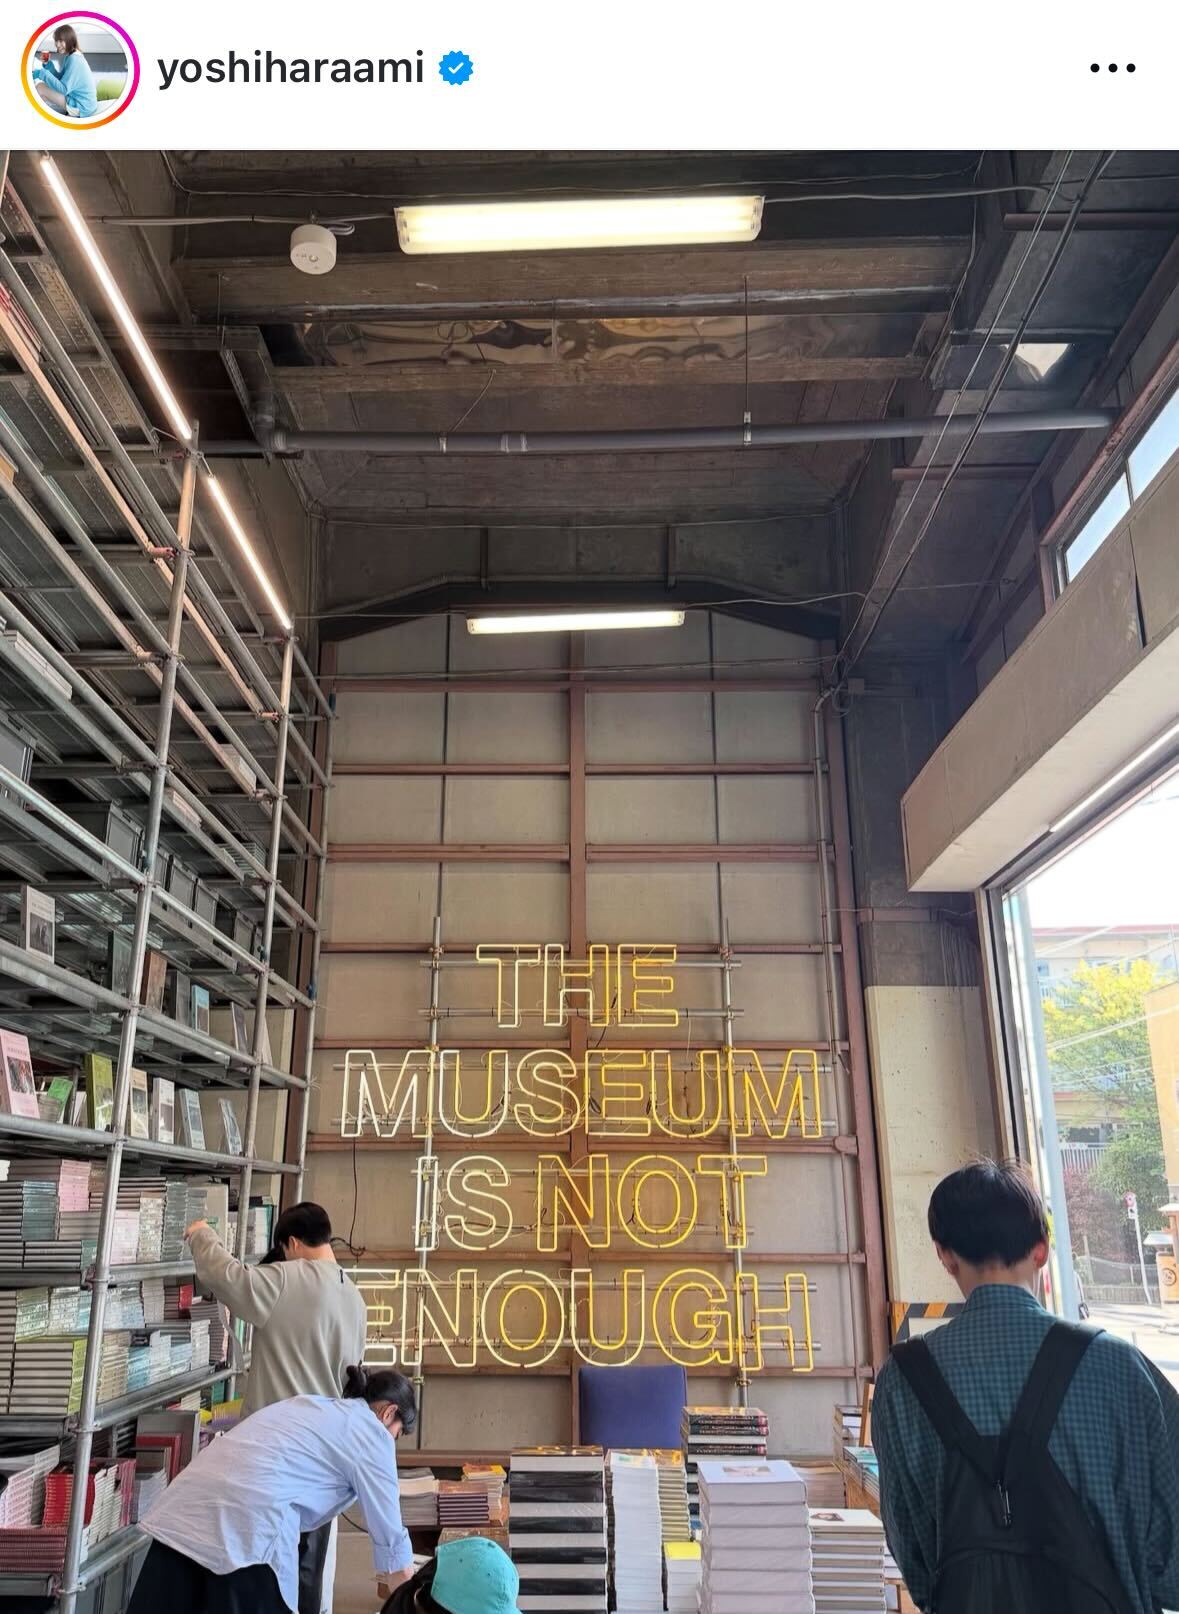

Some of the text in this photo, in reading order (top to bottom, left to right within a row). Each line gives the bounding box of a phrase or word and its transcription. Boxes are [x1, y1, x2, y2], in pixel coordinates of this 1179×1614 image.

[475, 943, 680, 1028] THE
[340, 1049, 824, 1139] MUSEUM
[414, 1153, 768, 1253] IS NOT
